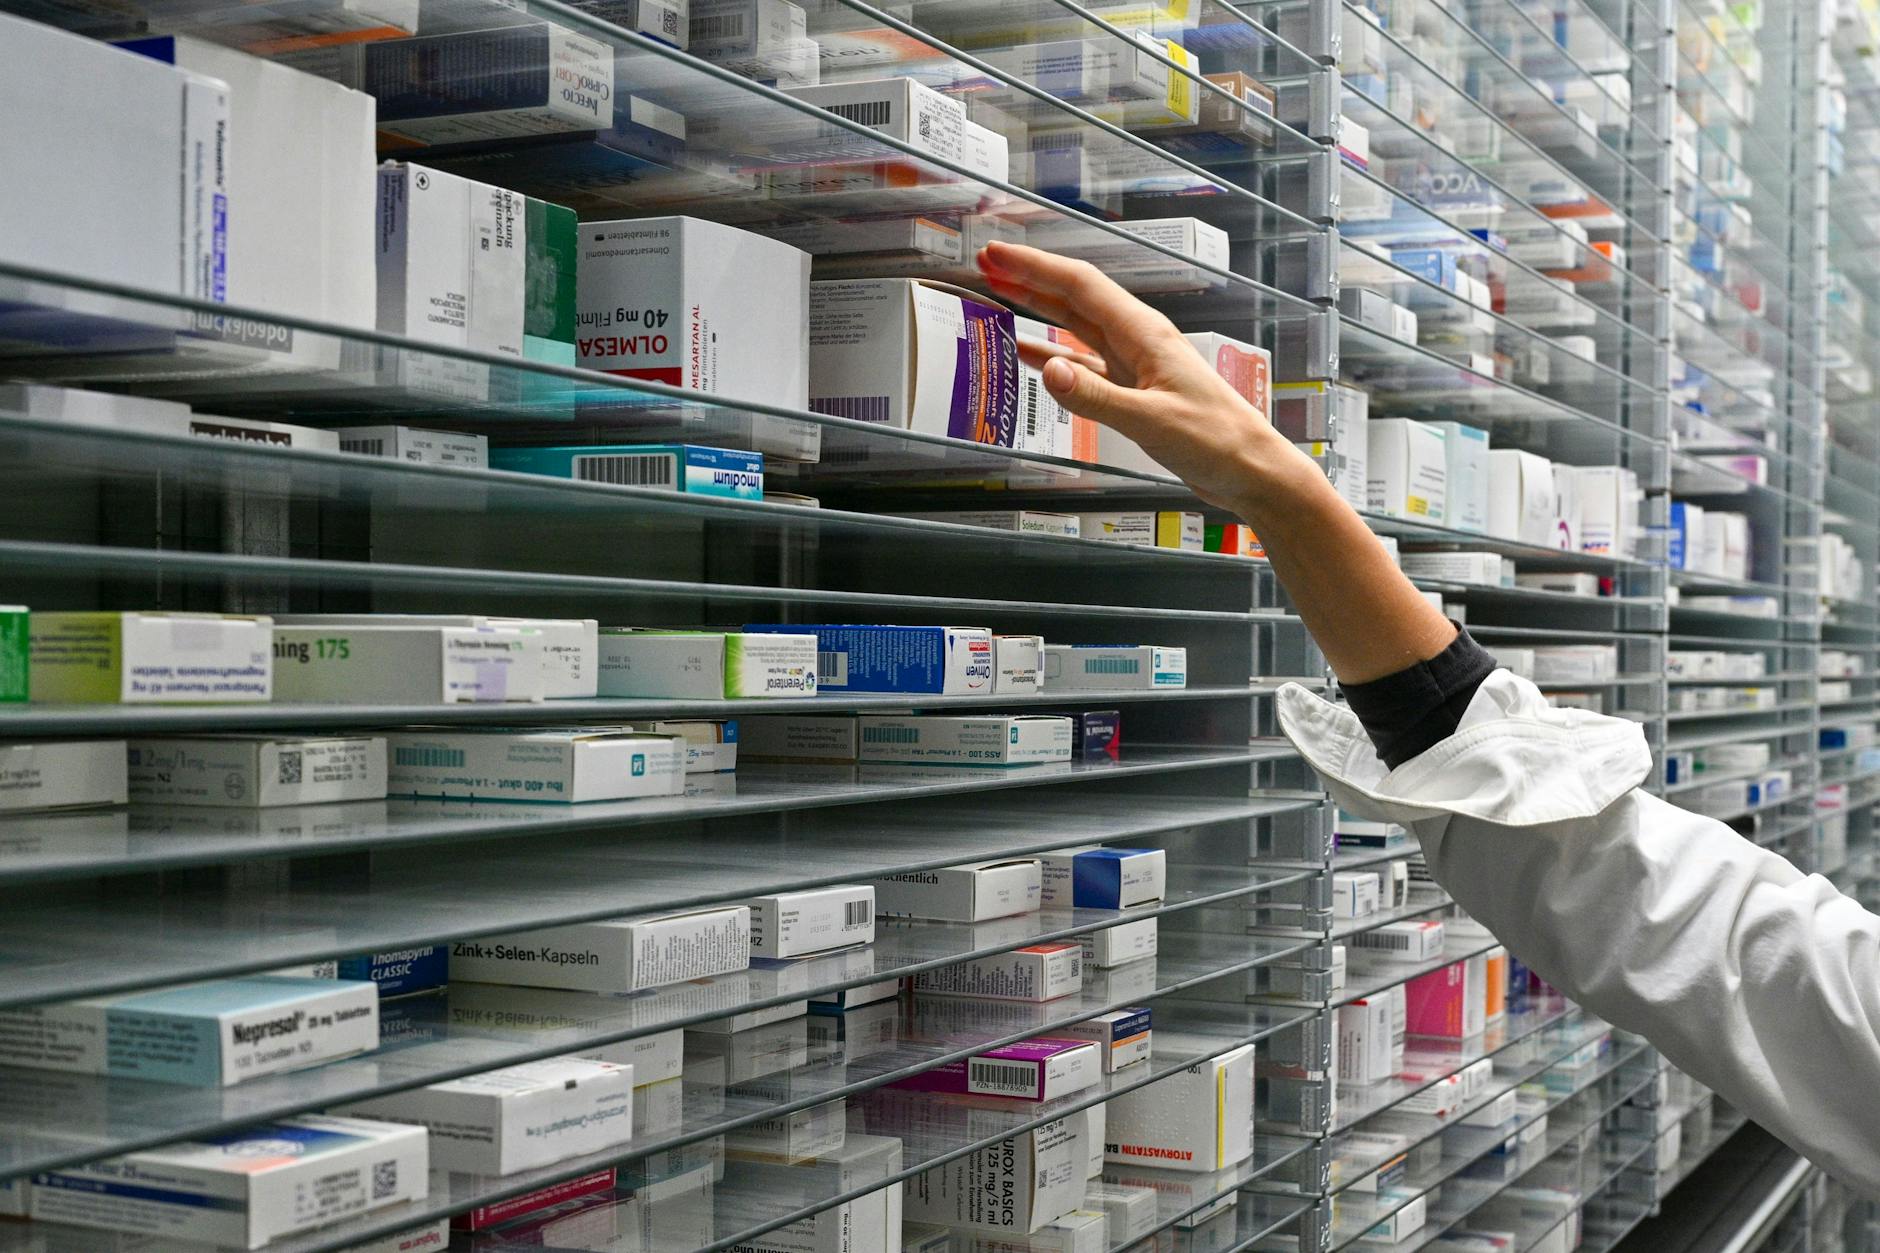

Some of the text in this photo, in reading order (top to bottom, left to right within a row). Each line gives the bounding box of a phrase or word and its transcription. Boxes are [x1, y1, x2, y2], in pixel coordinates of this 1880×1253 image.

[616, 308, 639, 323] mg
[643, 309, 669, 328] 40
[692, 304, 699, 319] AL
[578, 335, 668, 357] OLMESA
[983, 317, 998, 444] Schwangerschaft 2
[995, 315, 1017, 447] femibion
[714, 472, 760, 490] Imodium
[1064, 523, 1078, 534] forte
[315, 639, 349, 659] 175
[966, 665, 990, 679] Otriven
[968, 751, 982, 759] 100
[984, 751, 1001, 759] ASS
[157, 774, 171, 783] N2
[498, 779, 522, 790] akut
[525, 780, 544, 792] 400
[547, 781, 563, 792] Ibu
[453, 942, 599, 966] Zink+Selen-Kapseln
[371, 963, 412, 980] CLASSIC
[335, 1007, 371, 1021] Tabletten
[1121, 1144, 1192, 1161] ATORVASTATIN
[986, 1146, 999, 1225] 125 mg/5 ml
[1002, 1137, 1014, 1226] UROX BASICS
